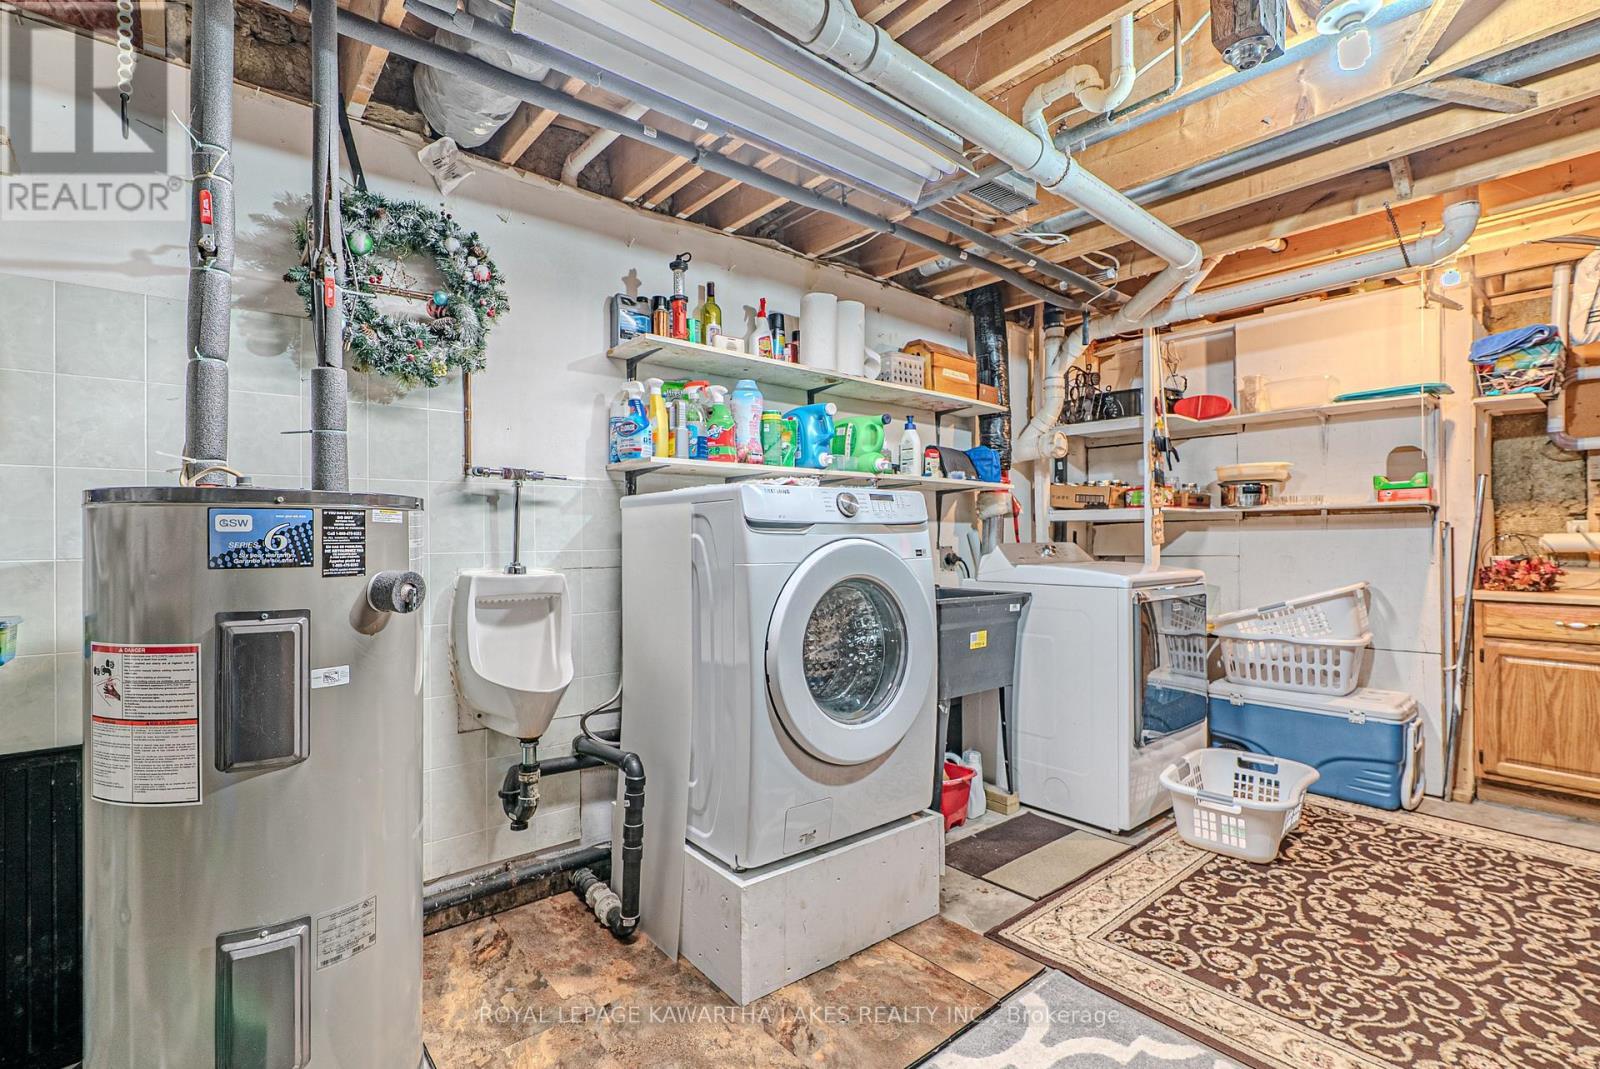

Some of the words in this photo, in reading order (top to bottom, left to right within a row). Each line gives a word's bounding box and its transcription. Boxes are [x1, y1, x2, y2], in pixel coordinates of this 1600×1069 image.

[219, 519, 249, 527] GSW
[228, 541, 260, 549] SERIES
[265, 522, 290, 551] 6
